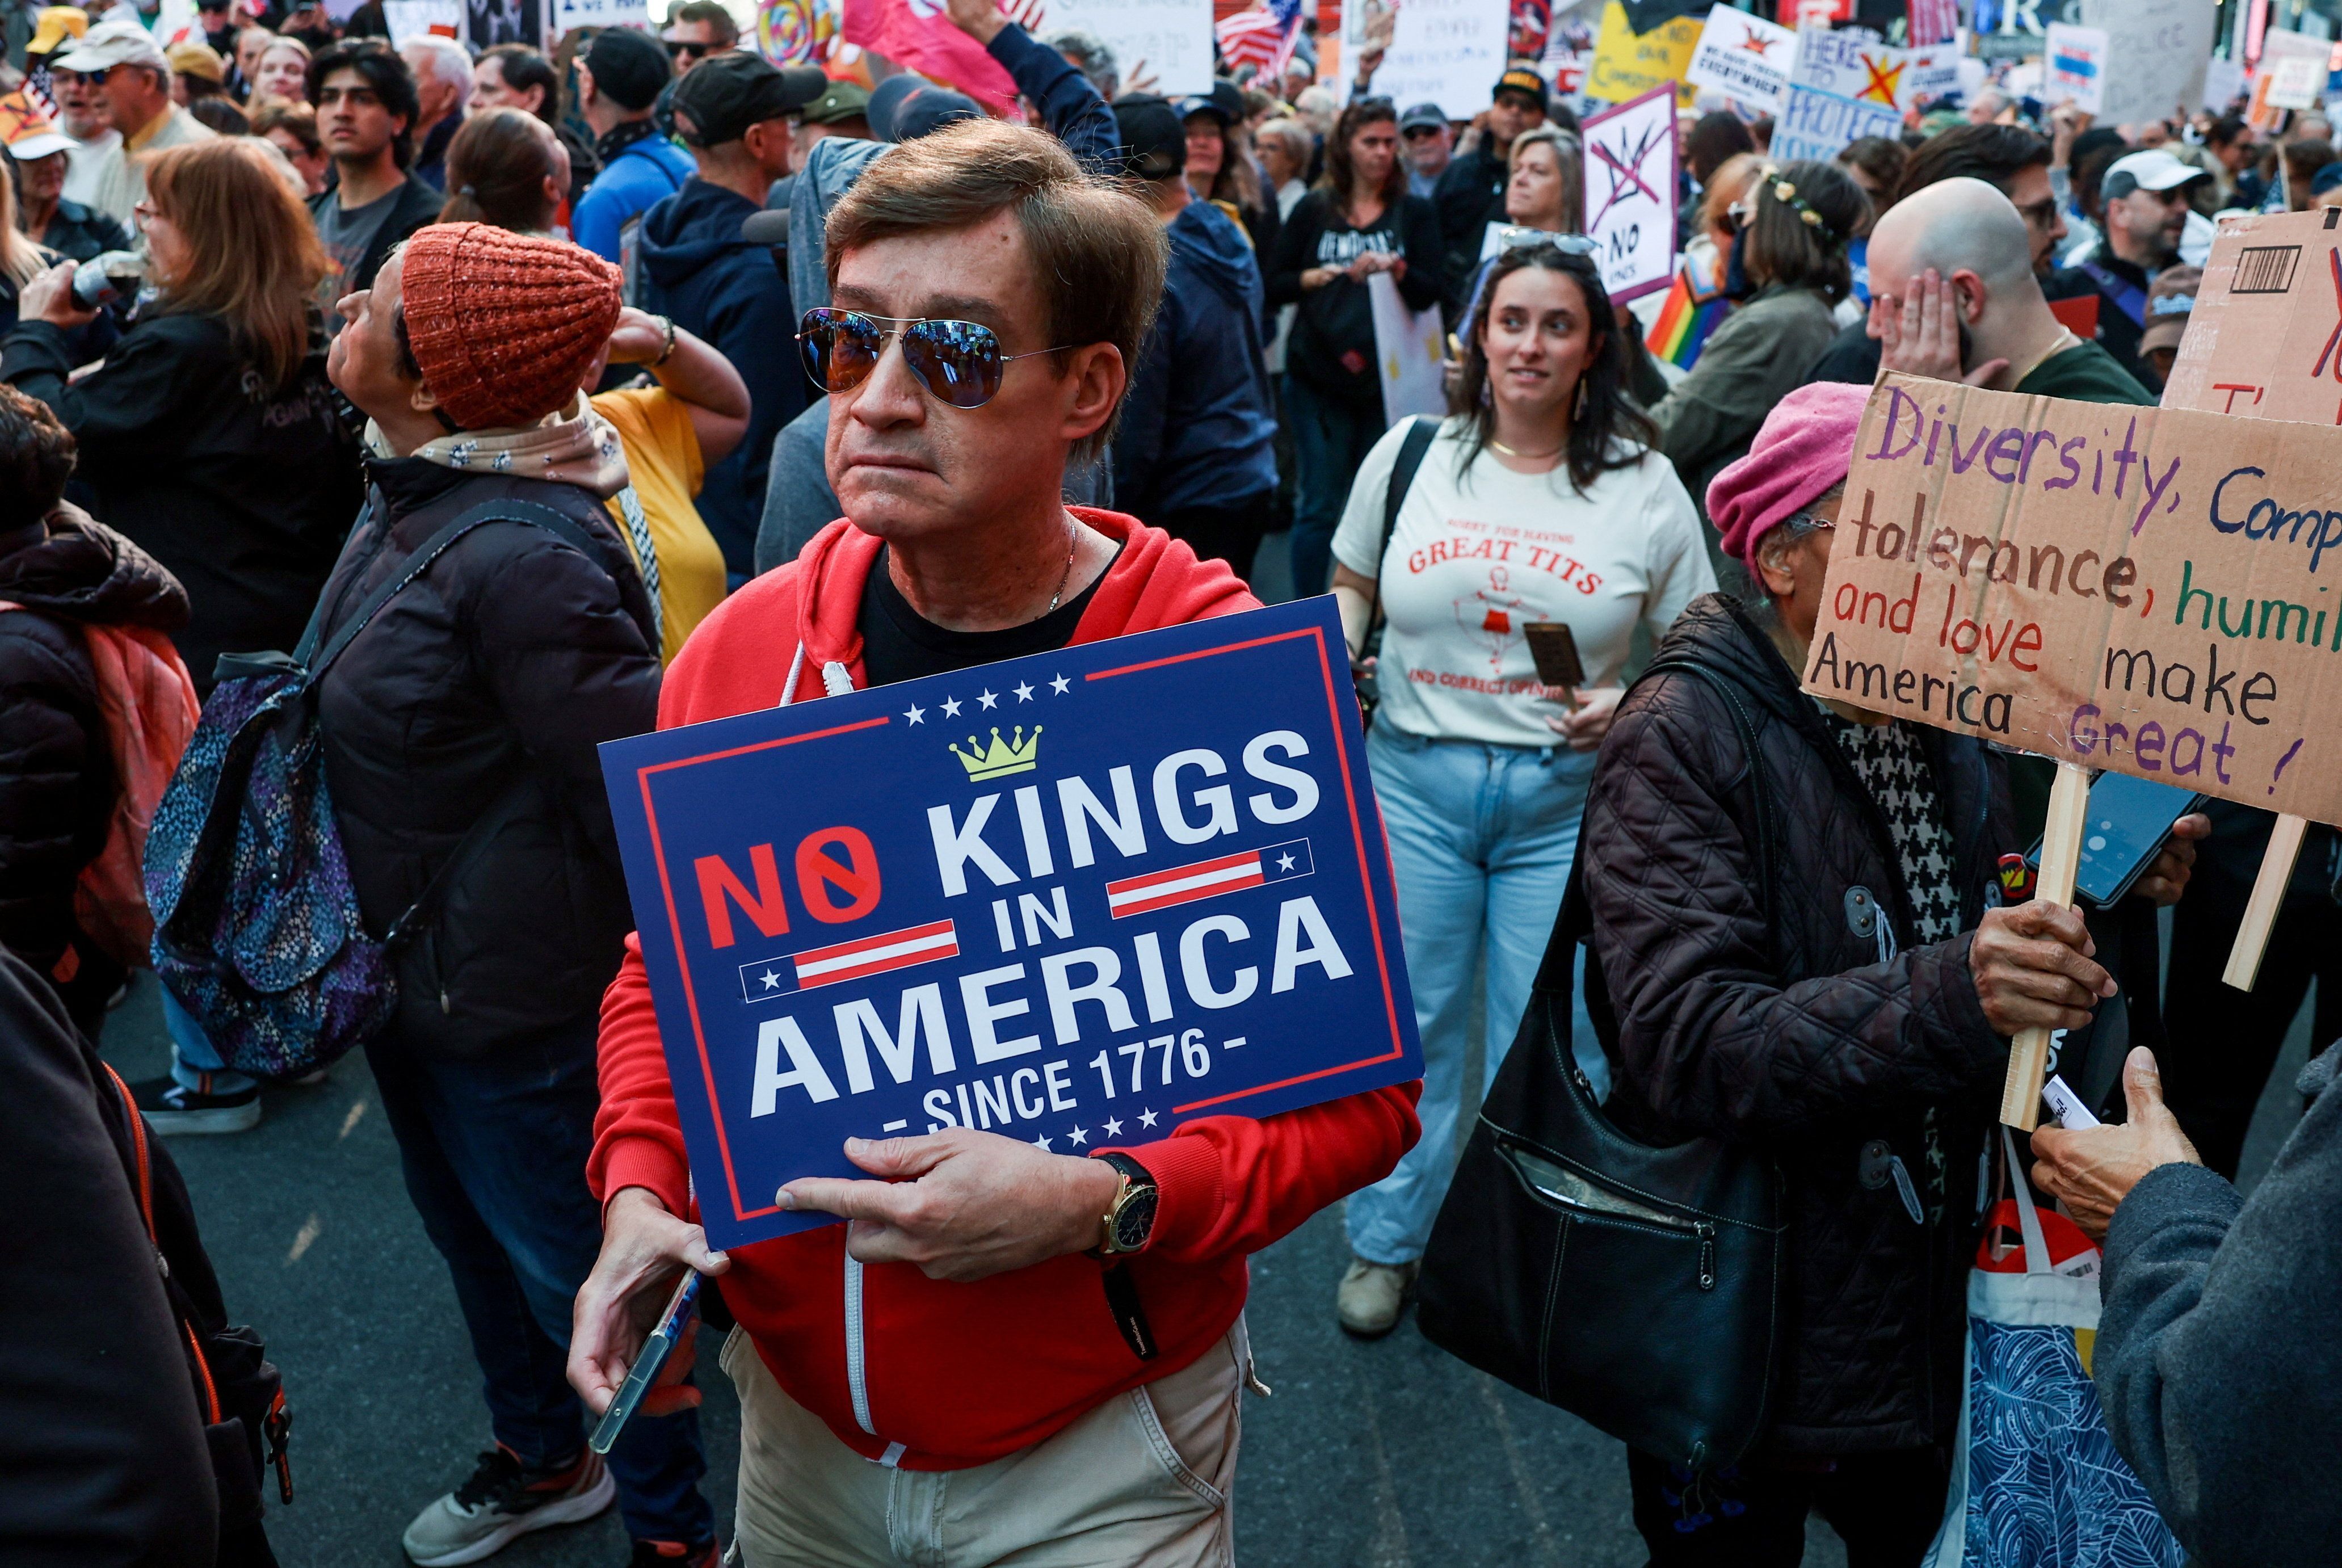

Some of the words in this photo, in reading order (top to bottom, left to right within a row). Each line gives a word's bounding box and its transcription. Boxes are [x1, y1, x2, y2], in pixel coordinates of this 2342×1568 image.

[1803, 62, 1837, 85] TO
[1804, 30, 1863, 70] HERE
[1786, 89, 1899, 141] PROTECT
[1609, 222, 1639, 263] NO
[1866, 385, 2181, 537] Diversity,
[1408, 537, 1519, 574] GREAT
[1528, 545, 1604, 596] TITS
[1851, 489, 2155, 618] tolerance,
[1439, 672, 1504, 695] CORRECT
[1834, 572, 1921, 634] and
[1939, 584, 2043, 672] love
[2105, 643, 2277, 725] make
[1809, 632, 2013, 734] America
[2070, 703, 2237, 785] Great
[695, 826, 881, 949] NO
[926, 730, 1320, 898] KINGS
[991, 886, 1074, 952] IN
[751, 896, 1355, 1118] AMERICA
[923, 1060, 1077, 1134] SINCE
[1089, 1028, 1211, 1099] 1776
